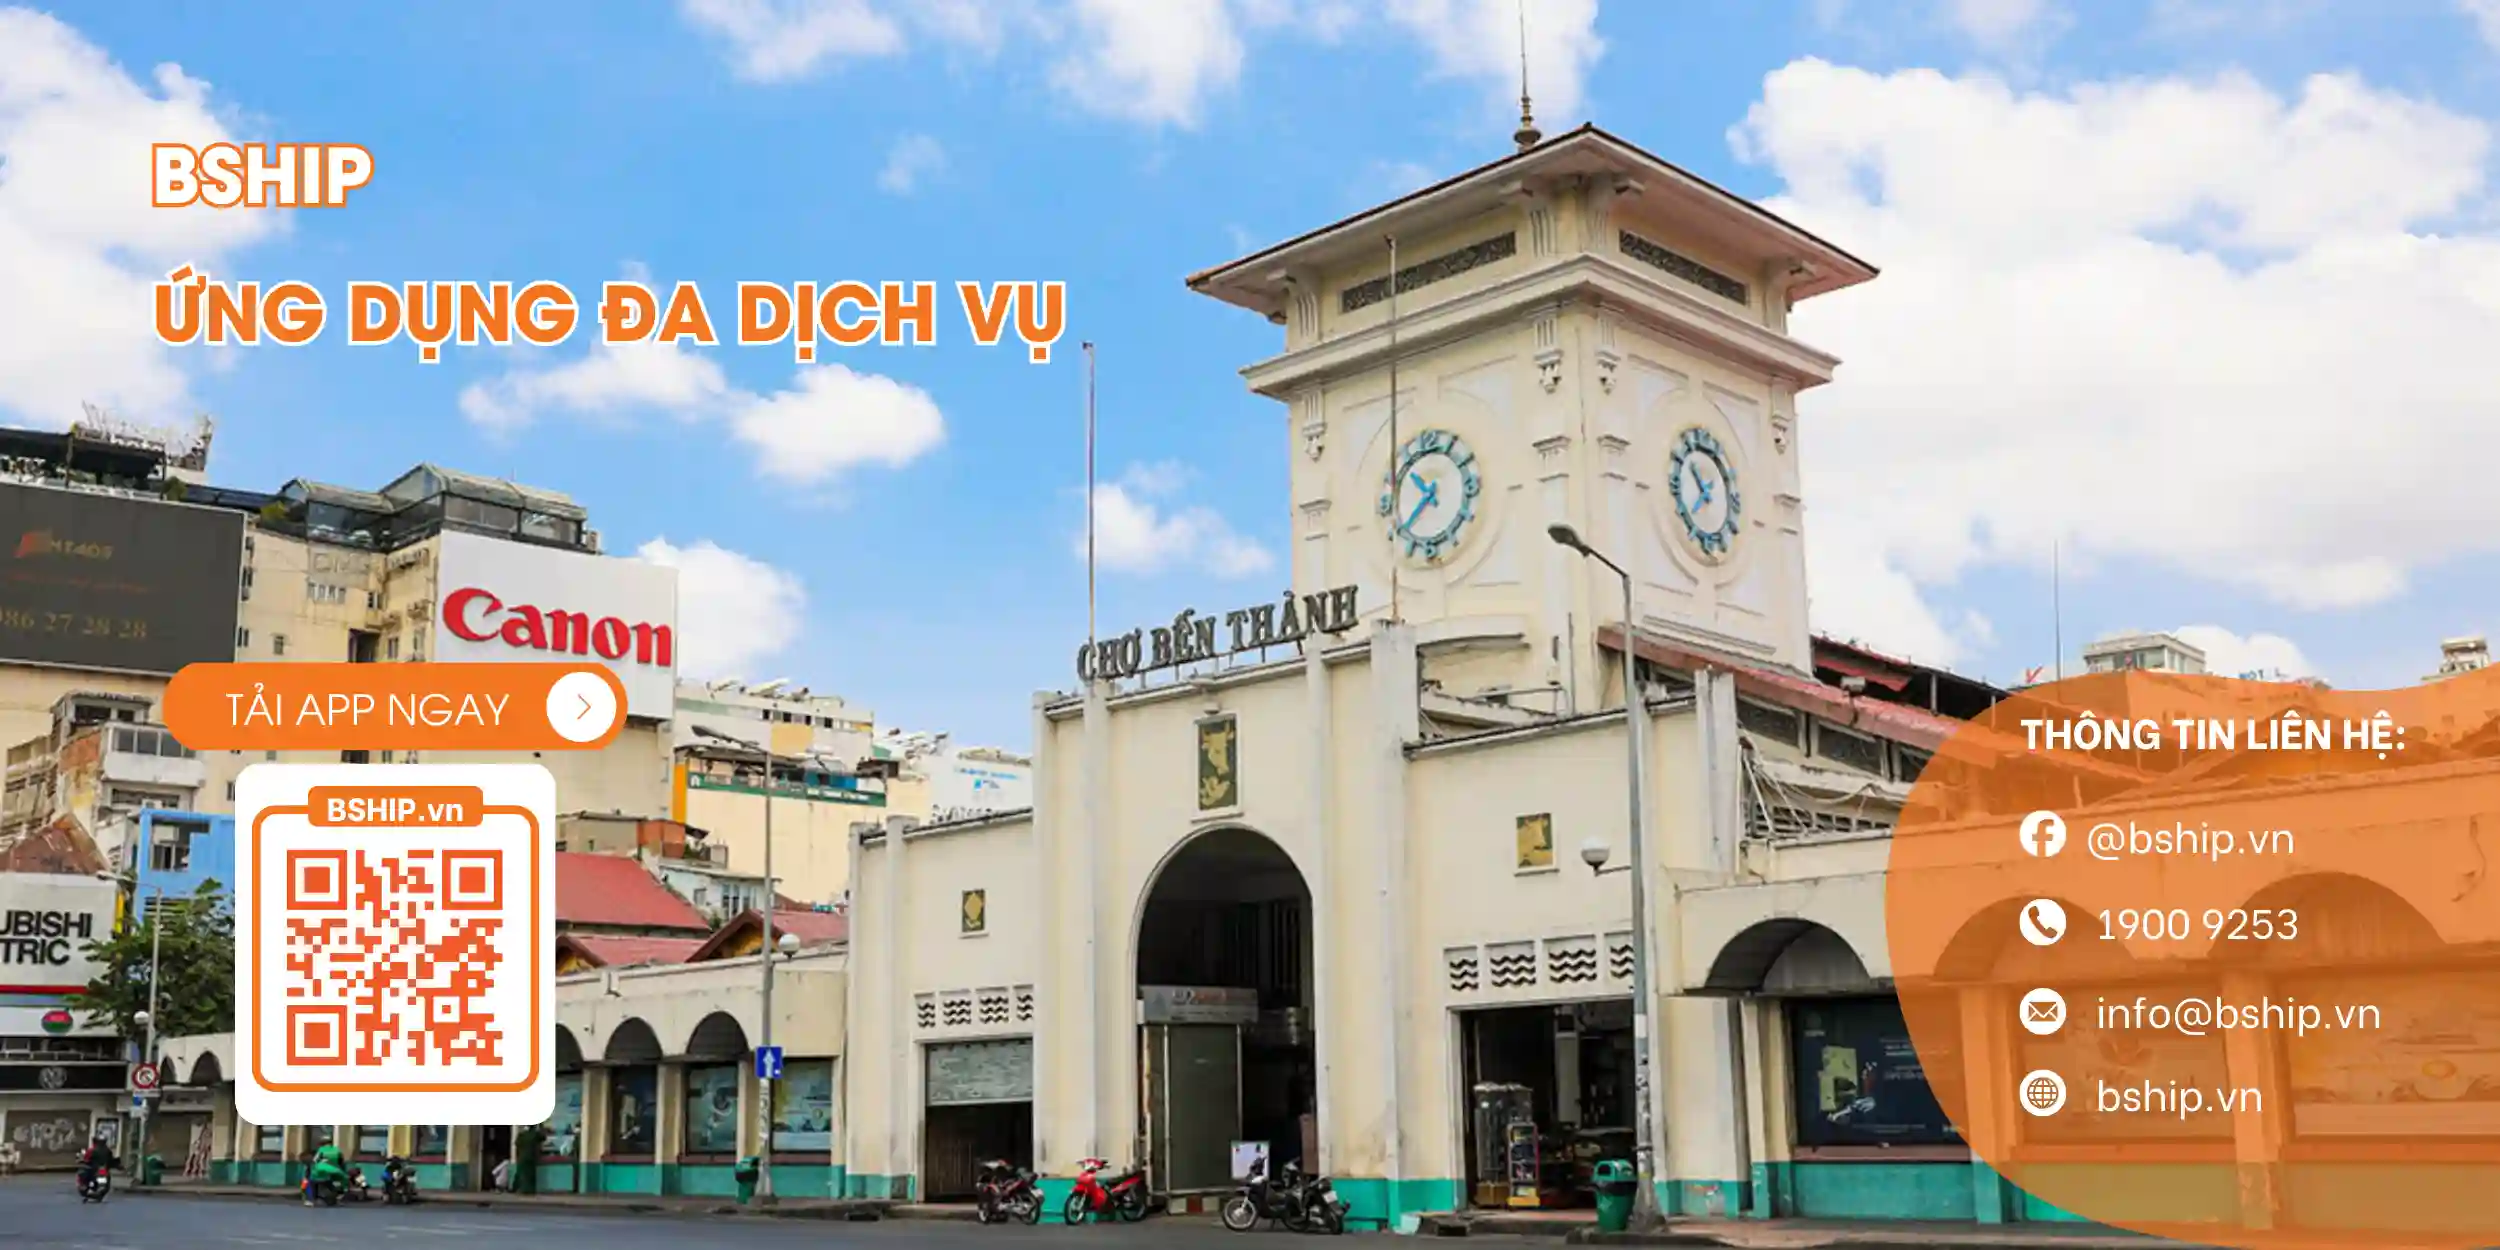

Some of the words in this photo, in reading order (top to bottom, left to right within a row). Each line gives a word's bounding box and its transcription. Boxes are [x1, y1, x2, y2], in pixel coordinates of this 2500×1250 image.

[0, 606, 35, 629] 86
[442, 587, 672, 667] Canon
[1150, 607, 1217, 667] BẾN
